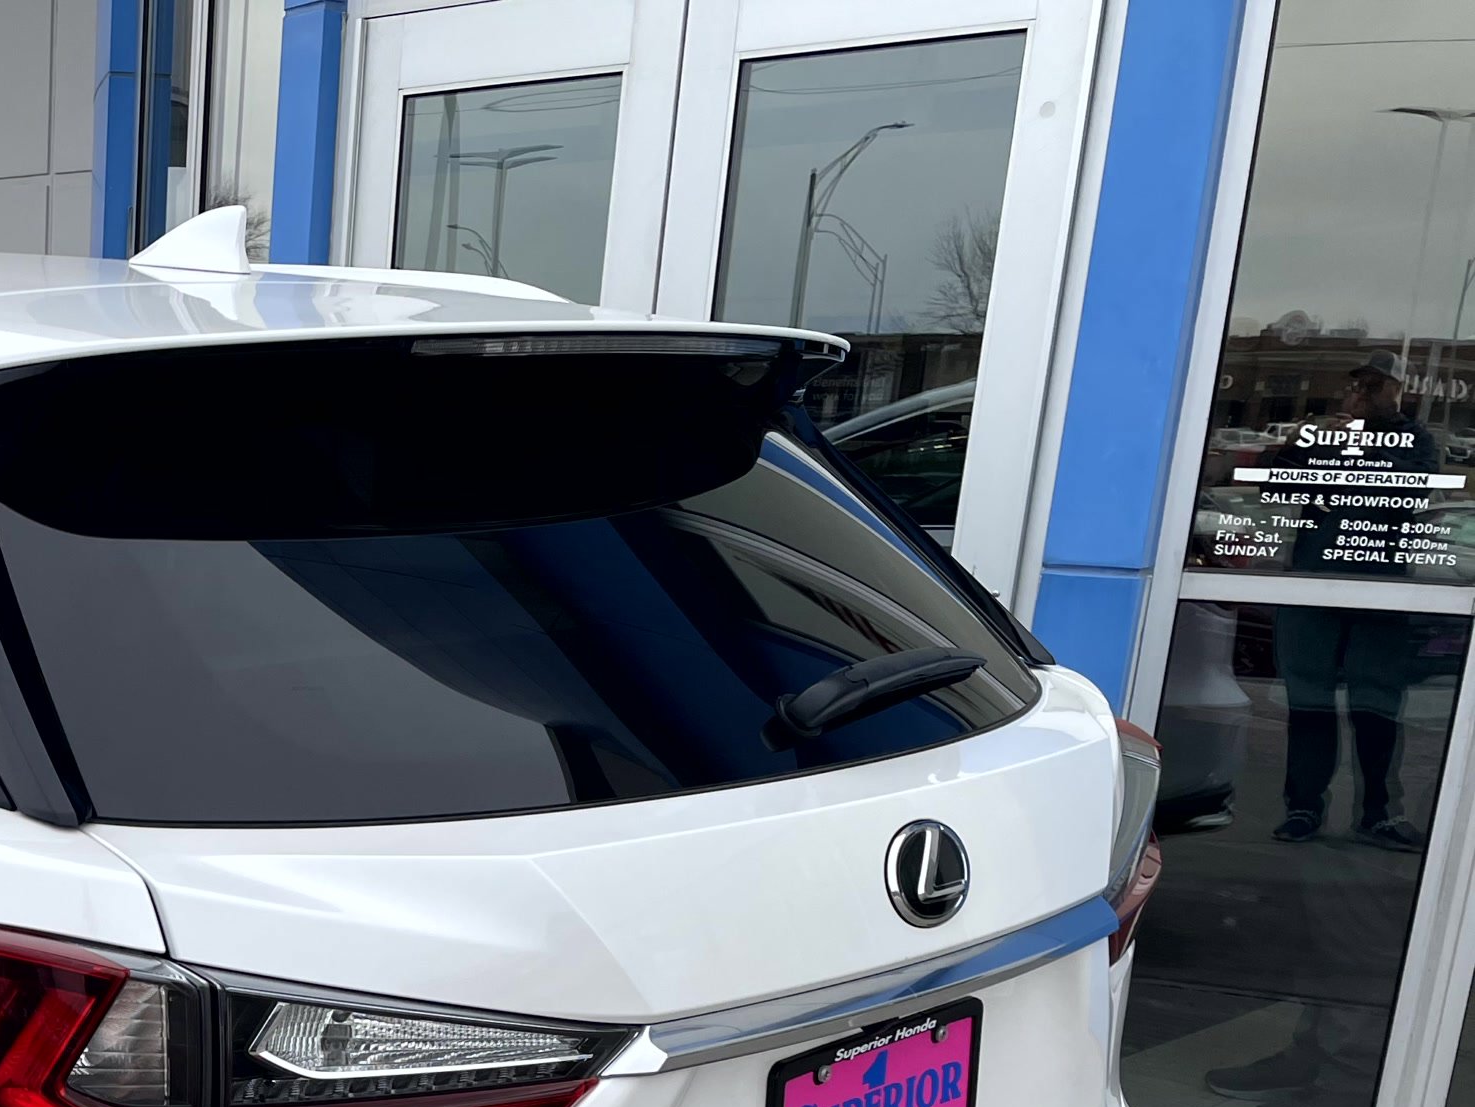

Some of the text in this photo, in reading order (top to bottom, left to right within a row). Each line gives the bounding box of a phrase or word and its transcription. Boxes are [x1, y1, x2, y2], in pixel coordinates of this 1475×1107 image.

[1295, 423, 1415, 449] SUPERIOR
[1308, 457, 1393, 468] Honda of Omaha
[1269, 470, 1428, 486] HOURS OF OPERATION
[1260, 492, 1429, 509] SALES & SHOWROOM
[1218, 514, 1256, 526] Mon.
[1271, 515, 1319, 529] Thurs.
[1215, 530, 1240, 542] Fri.
[1254, 531, 1283, 544] Sat.
[1214, 544, 1278, 557] SUNDAY
[1322, 548, 1457, 566] SPECIAL EVENTS
[834, 1018, 937, 1062] Superior Honda
